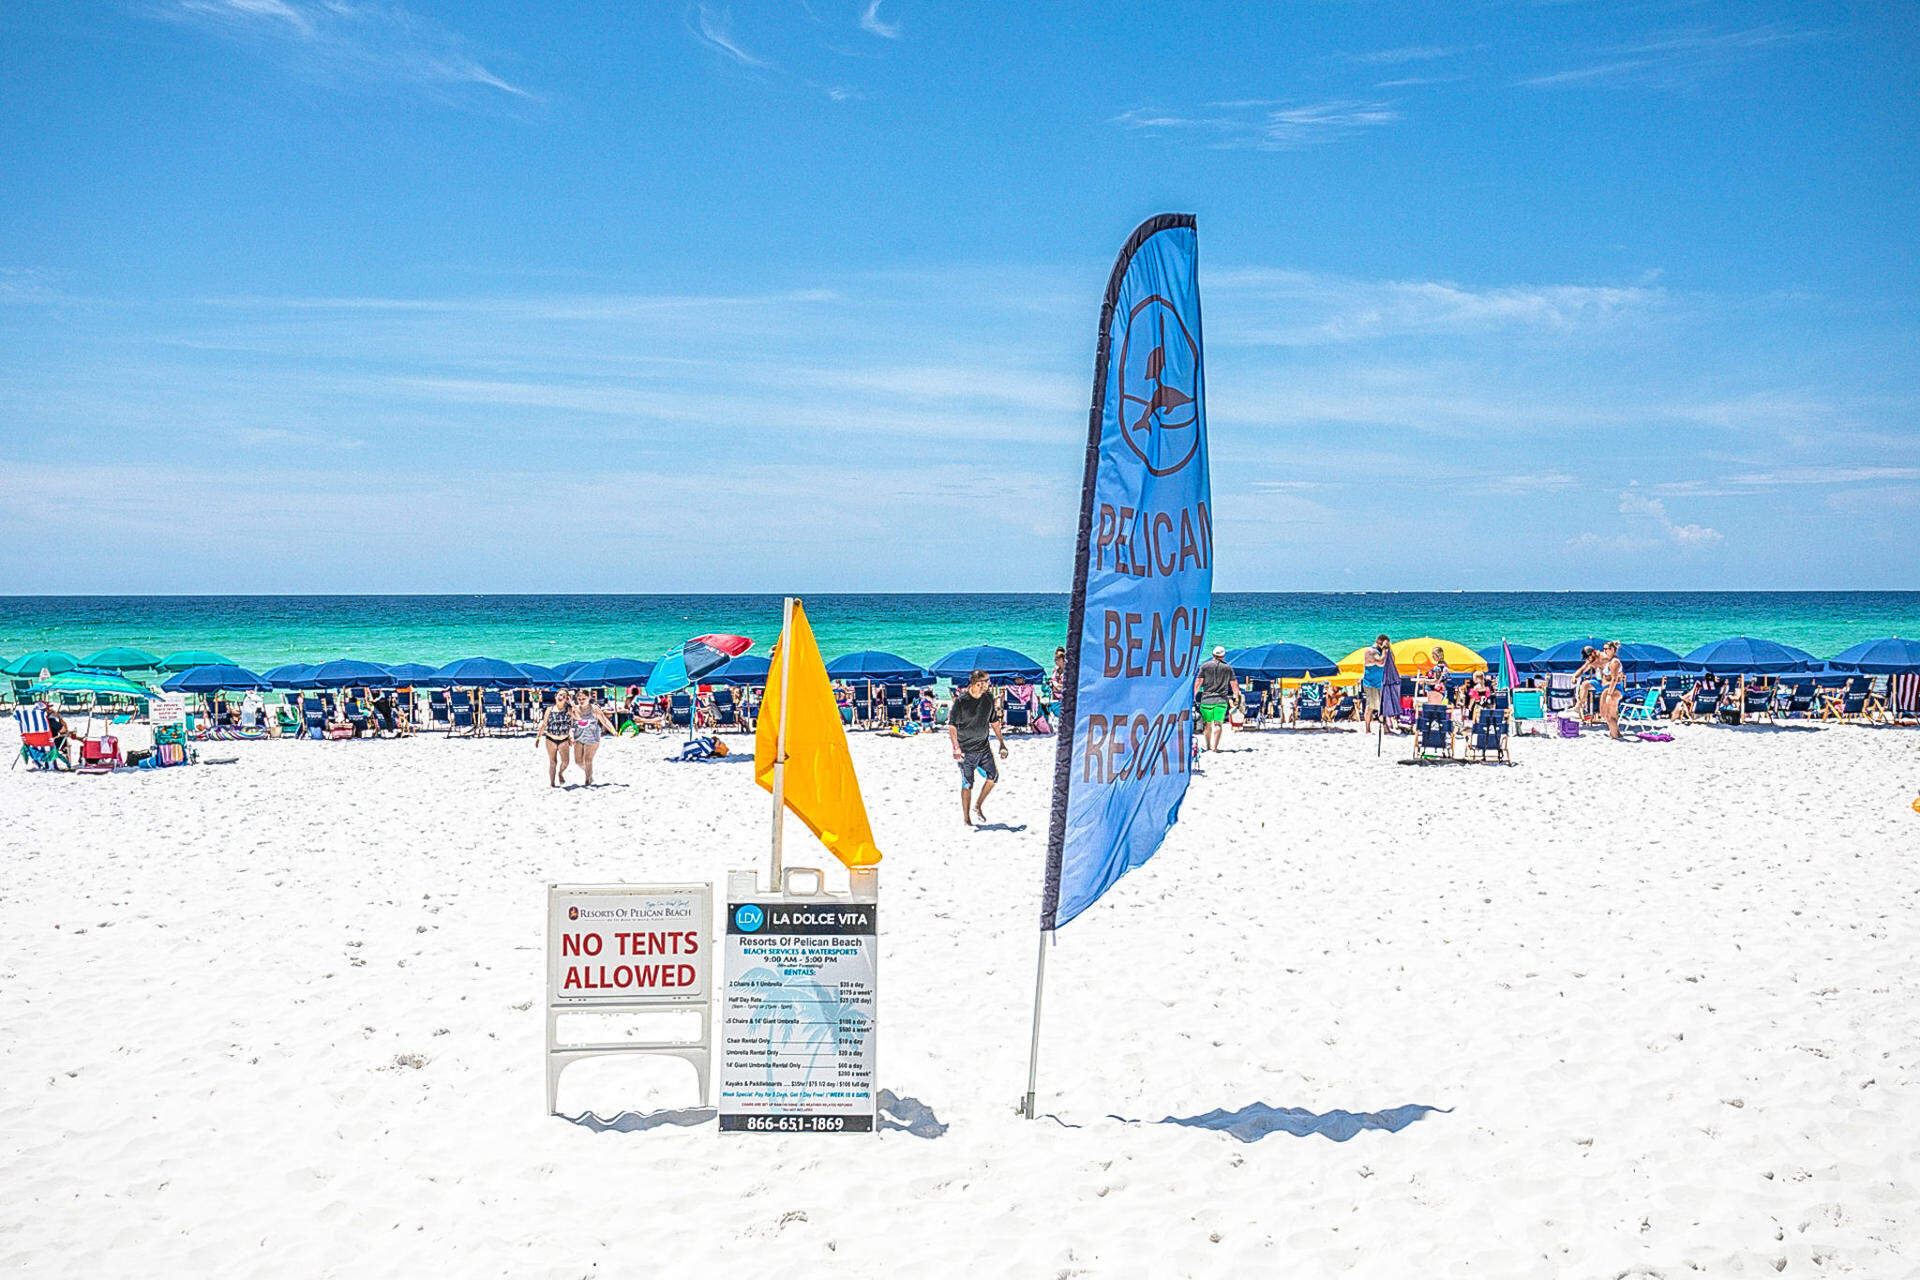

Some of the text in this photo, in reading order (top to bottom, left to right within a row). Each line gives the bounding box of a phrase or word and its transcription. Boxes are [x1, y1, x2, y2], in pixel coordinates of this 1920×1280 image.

[1103, 606, 1207, 678] BEACH
[1083, 710, 1190, 785] RESORT
[738, 912, 868, 925] LDV LA DOLCE VITA
[562, 931, 698, 956] NO TENTS
[740, 937, 862, 946] Resorts Of Pelican Beach
[563, 964, 696, 989] ALLOWED
[747, 1117, 844, 1131] 866-651-1869
